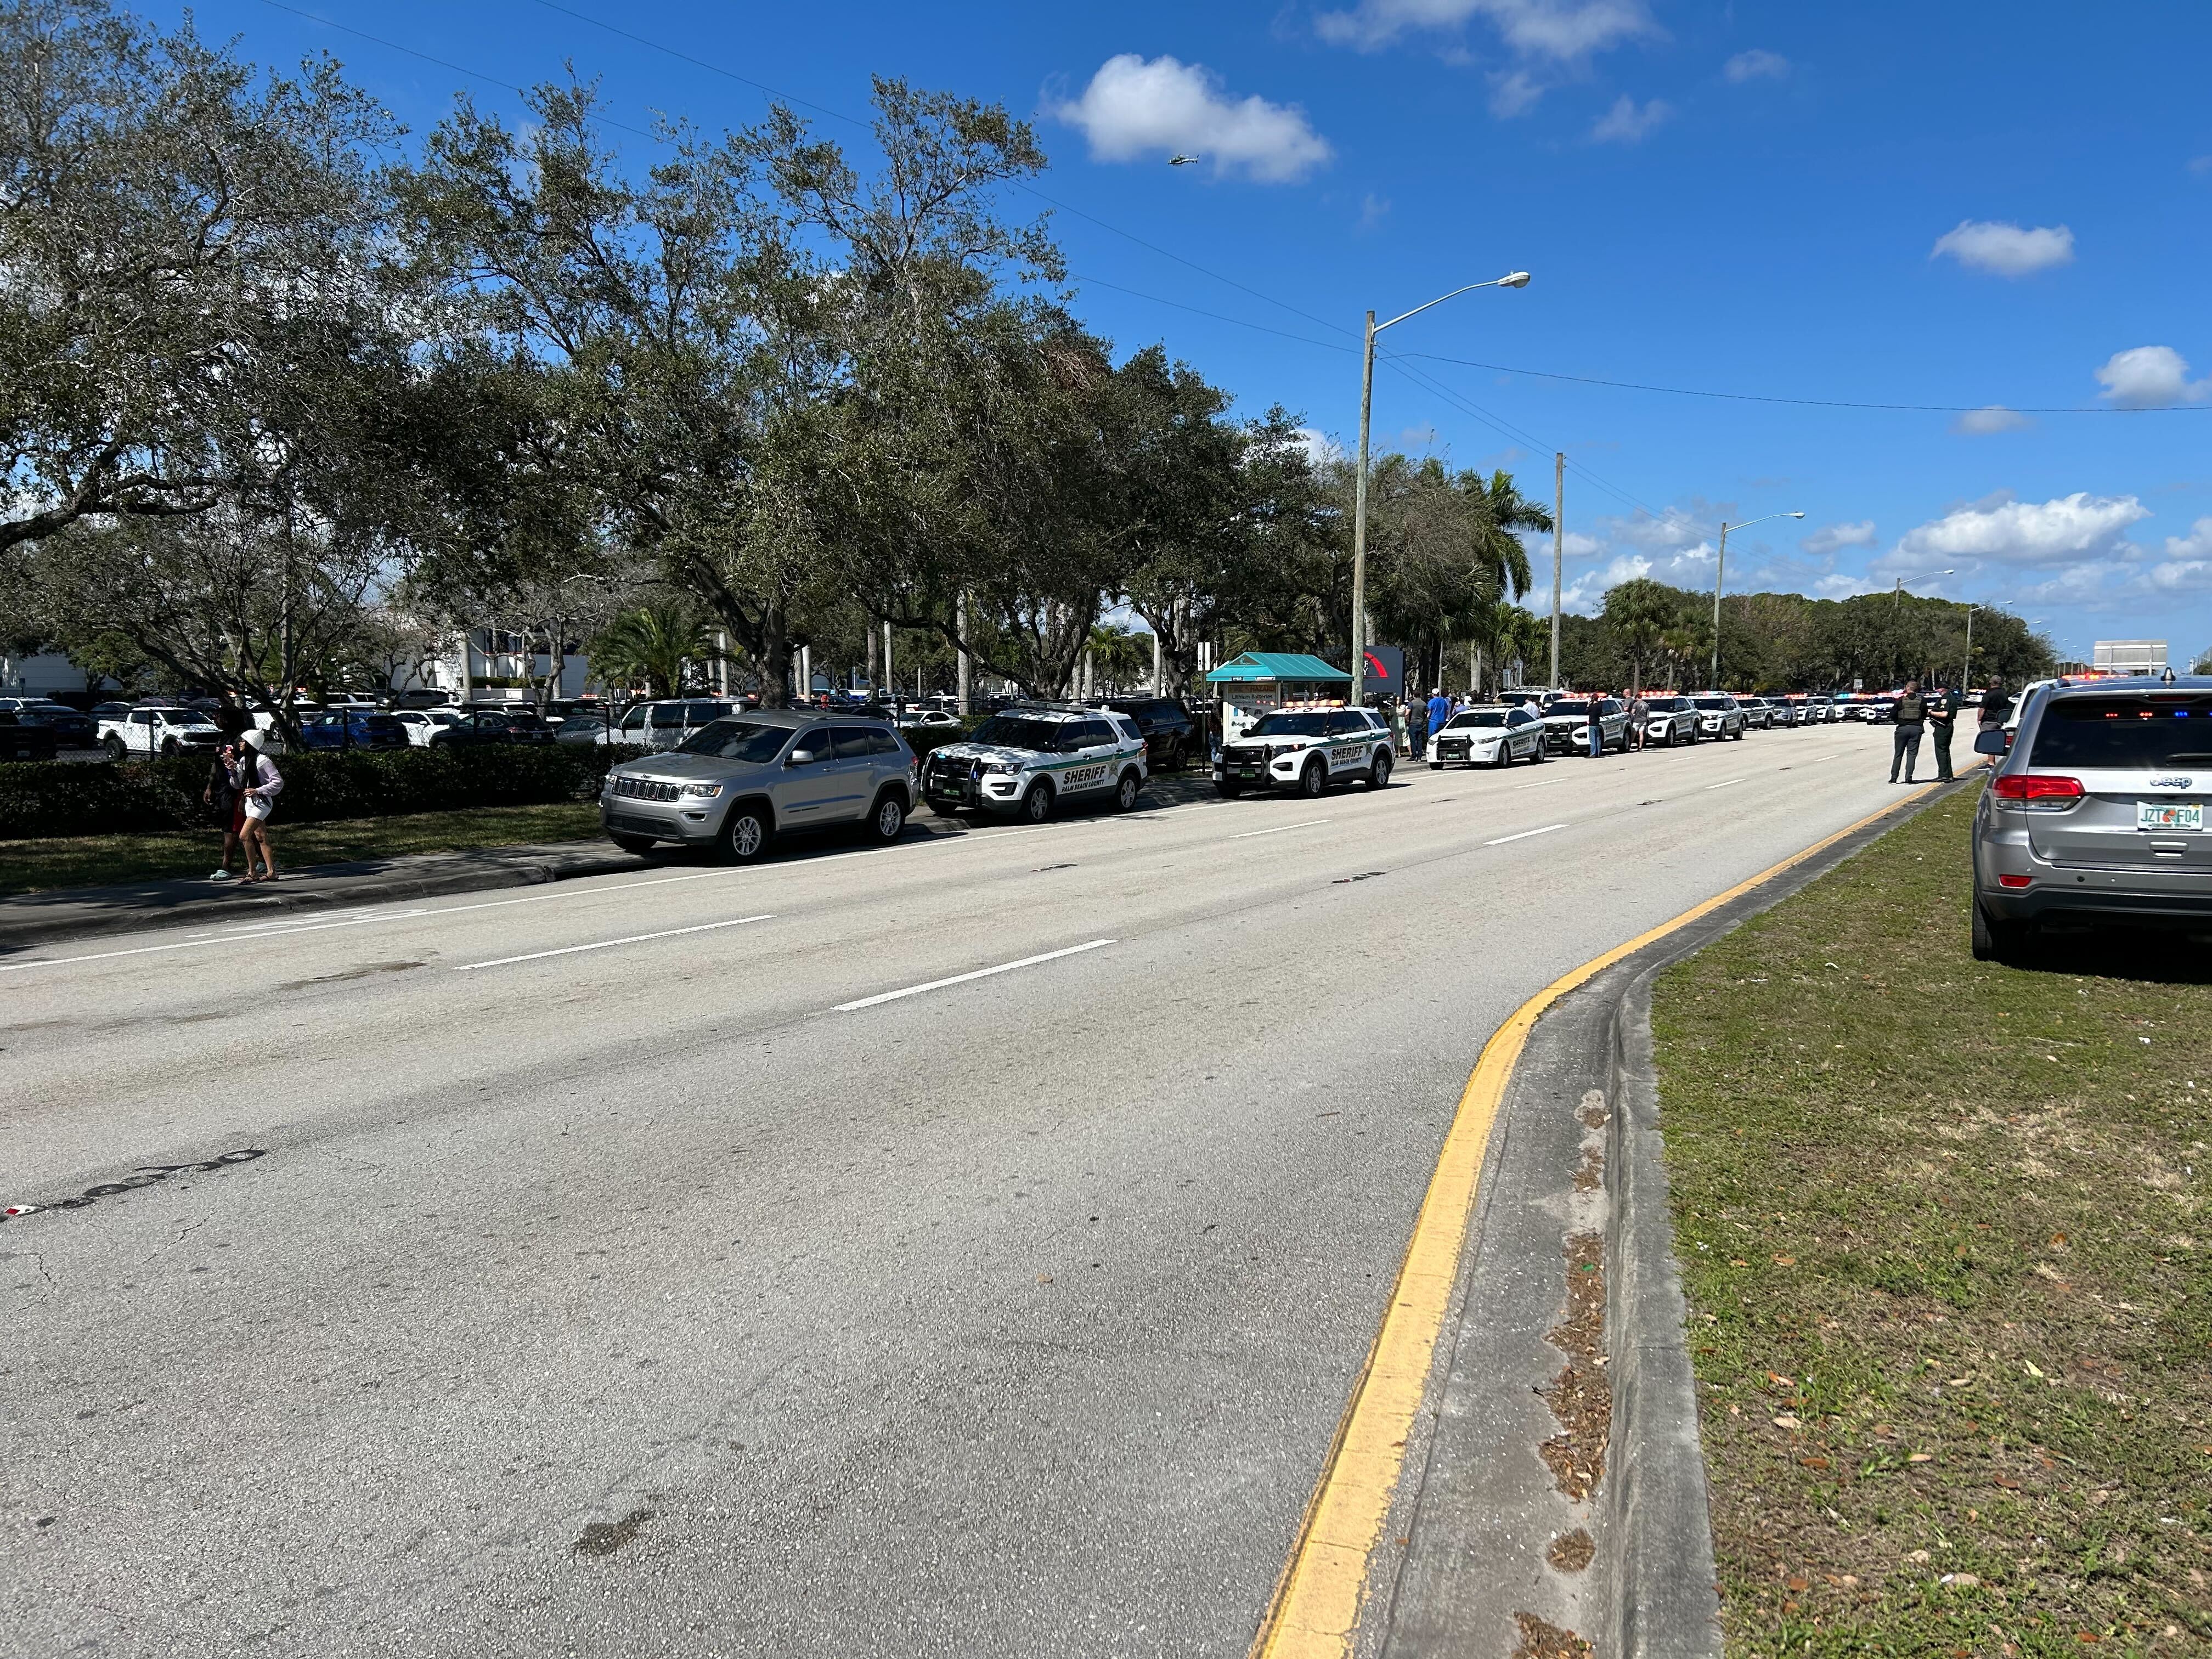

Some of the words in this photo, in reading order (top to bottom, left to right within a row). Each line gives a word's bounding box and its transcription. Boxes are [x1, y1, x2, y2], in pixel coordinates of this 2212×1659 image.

[1331, 746, 1363, 760] SHERIFF
[1063, 765, 1107, 785] SHERIFF
[2150, 777, 2192, 789] Jeep
[2141, 809, 2160, 822] JZT
